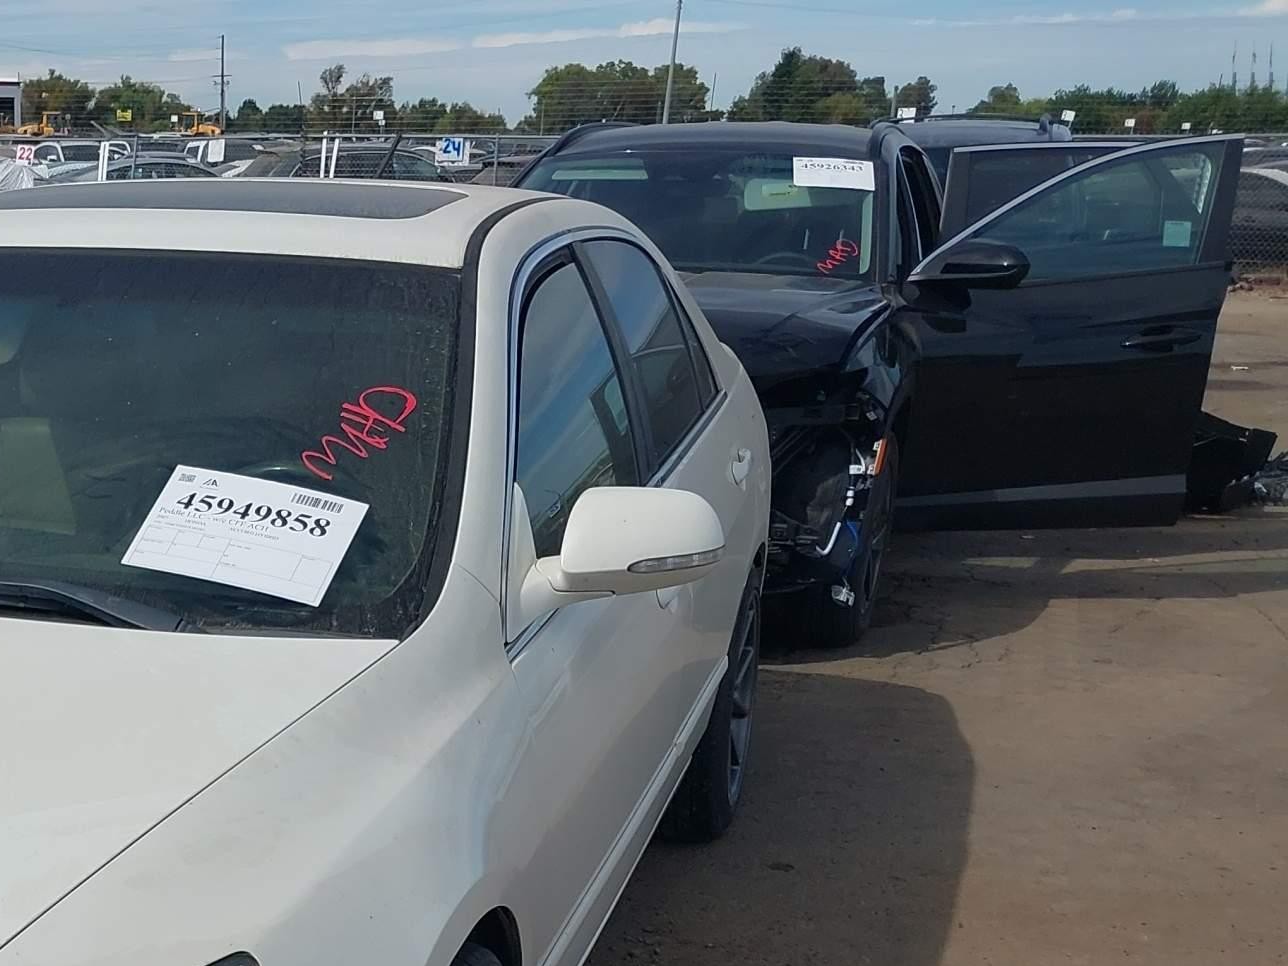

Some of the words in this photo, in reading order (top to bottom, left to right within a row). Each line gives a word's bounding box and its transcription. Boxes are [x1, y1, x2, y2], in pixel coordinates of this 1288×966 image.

[18, 146, 33, 161] 22
[442, 138, 461, 157] 24
[800, 161, 864, 172] 45926343
[176, 491, 332, 538] 45949858
